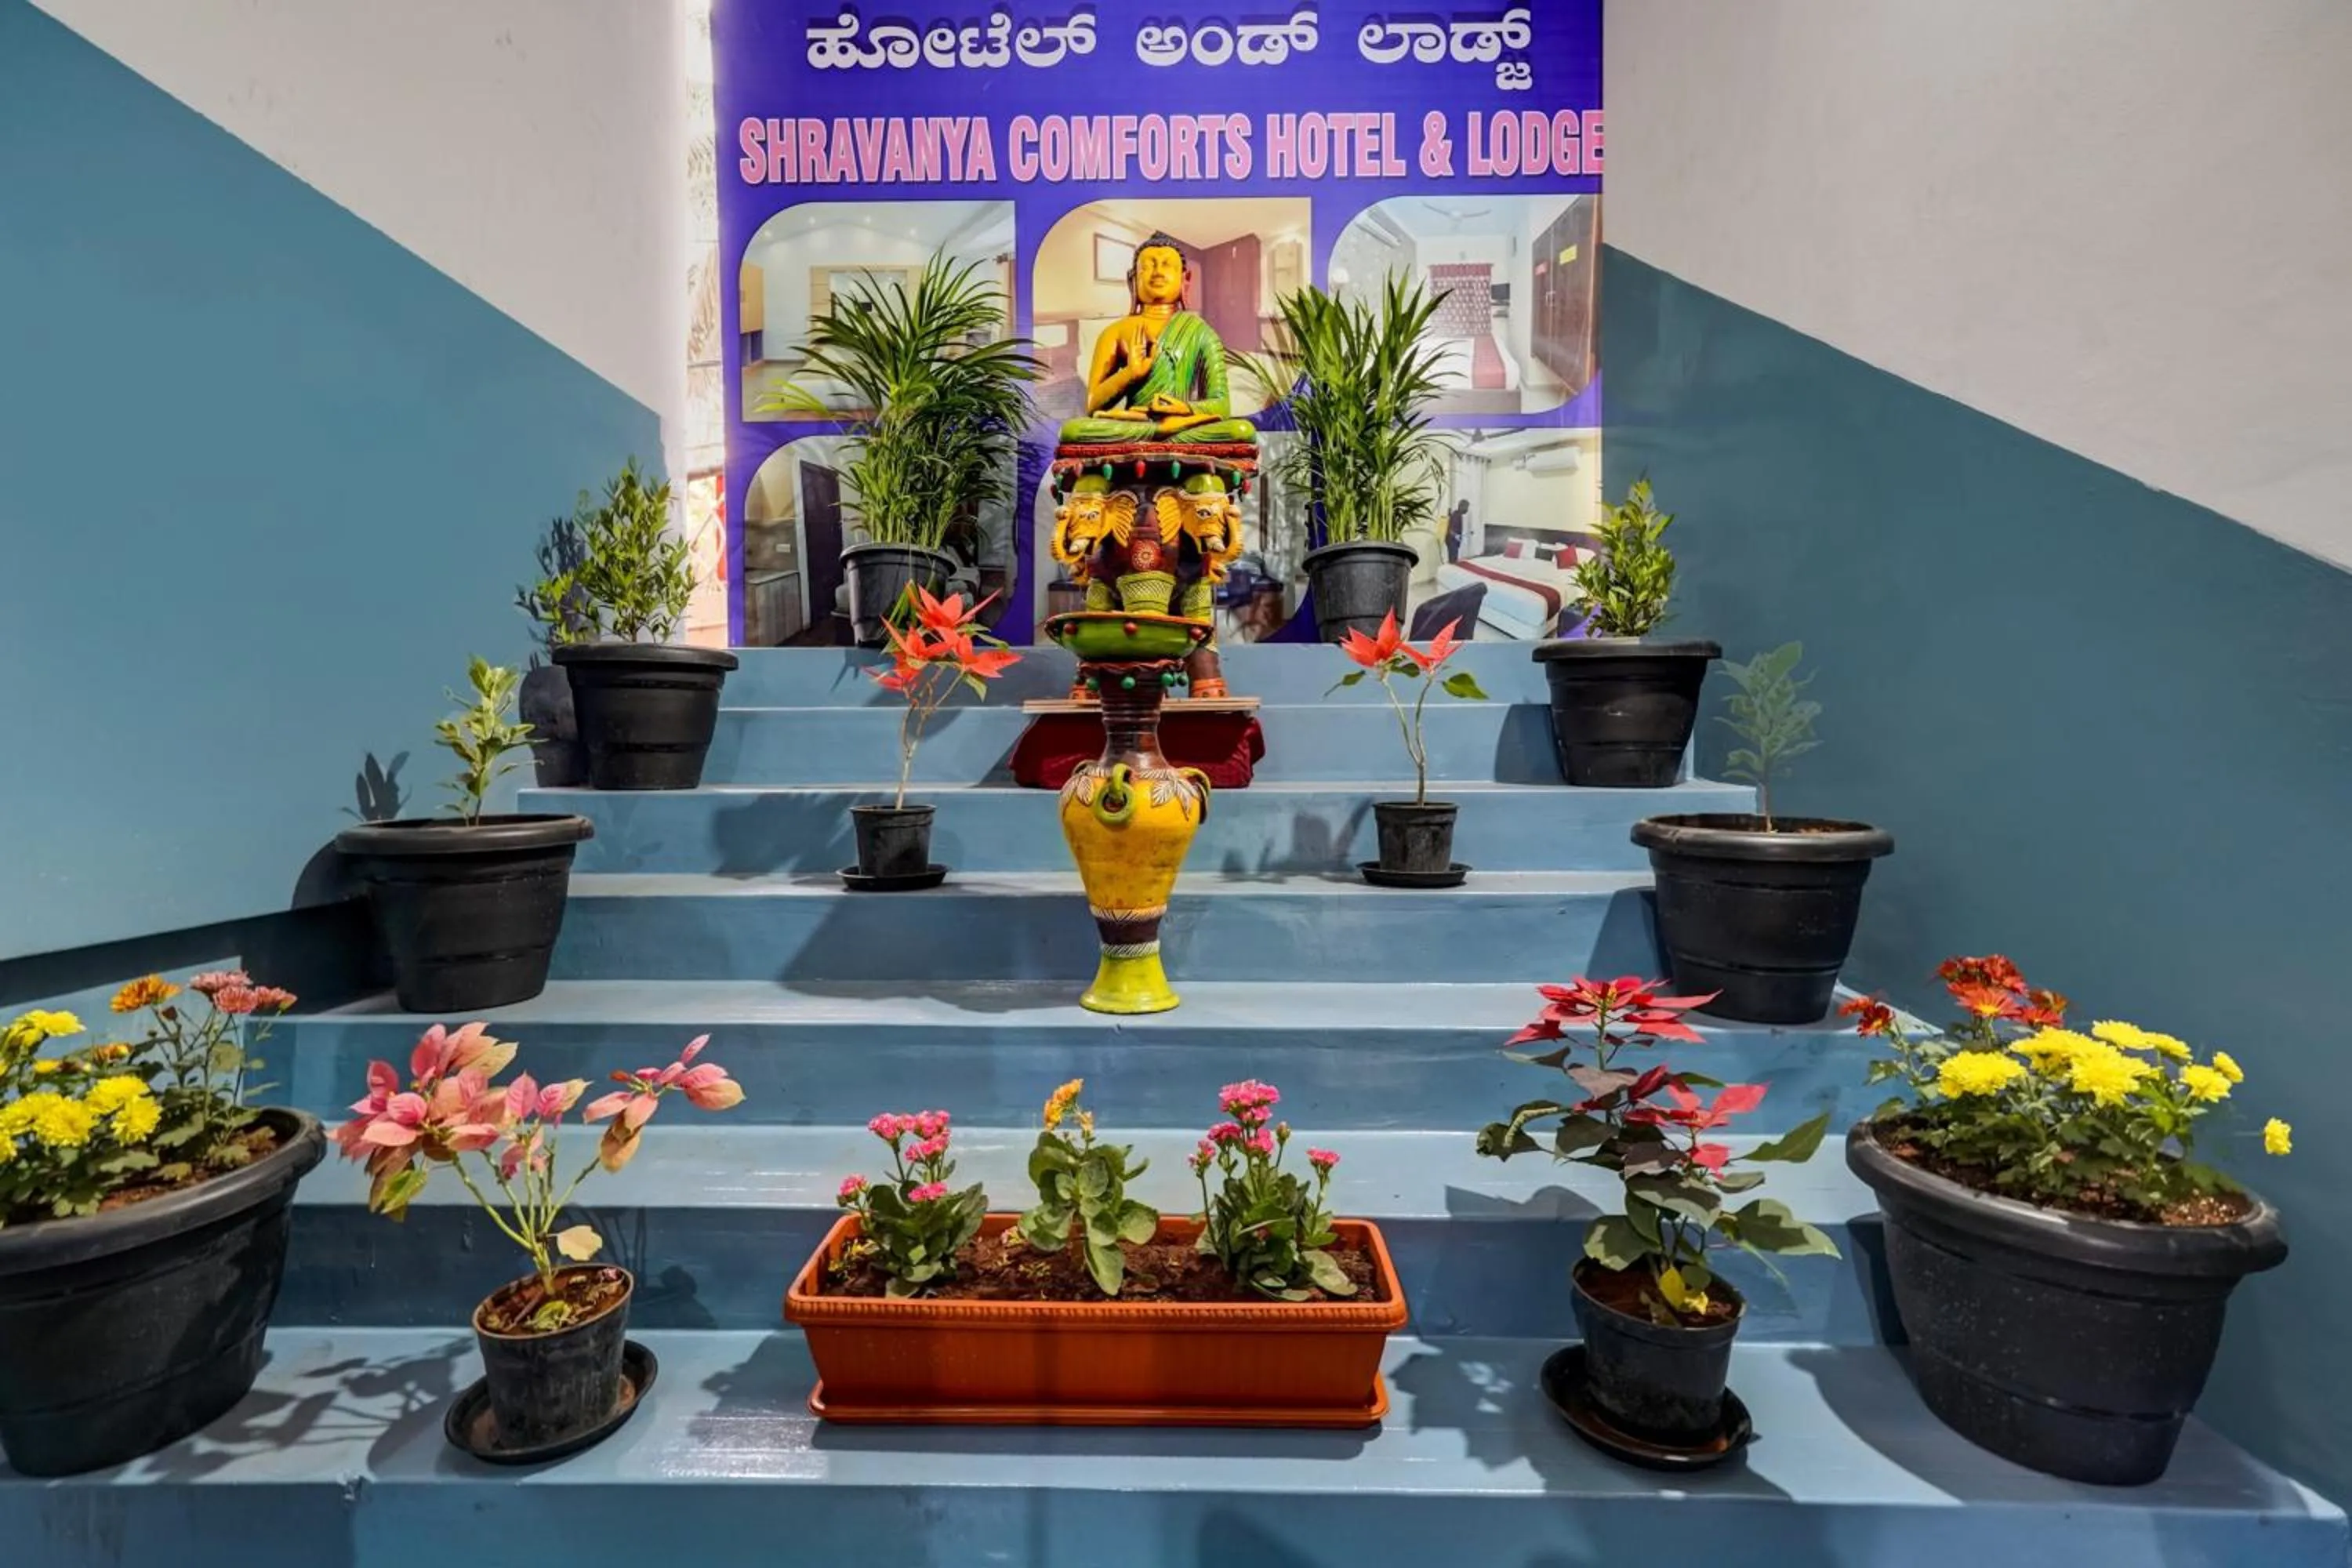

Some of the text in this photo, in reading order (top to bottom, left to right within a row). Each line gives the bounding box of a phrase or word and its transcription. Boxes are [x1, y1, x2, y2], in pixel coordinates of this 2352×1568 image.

[806, 9, 1533, 90] ಹೋಟೆಲ್ ಅಂಡ್ ಲಾಡ್ಜ್
[739, 109, 1603, 183] SHRAVANYA COMFORTS HOTEL & LODGE
